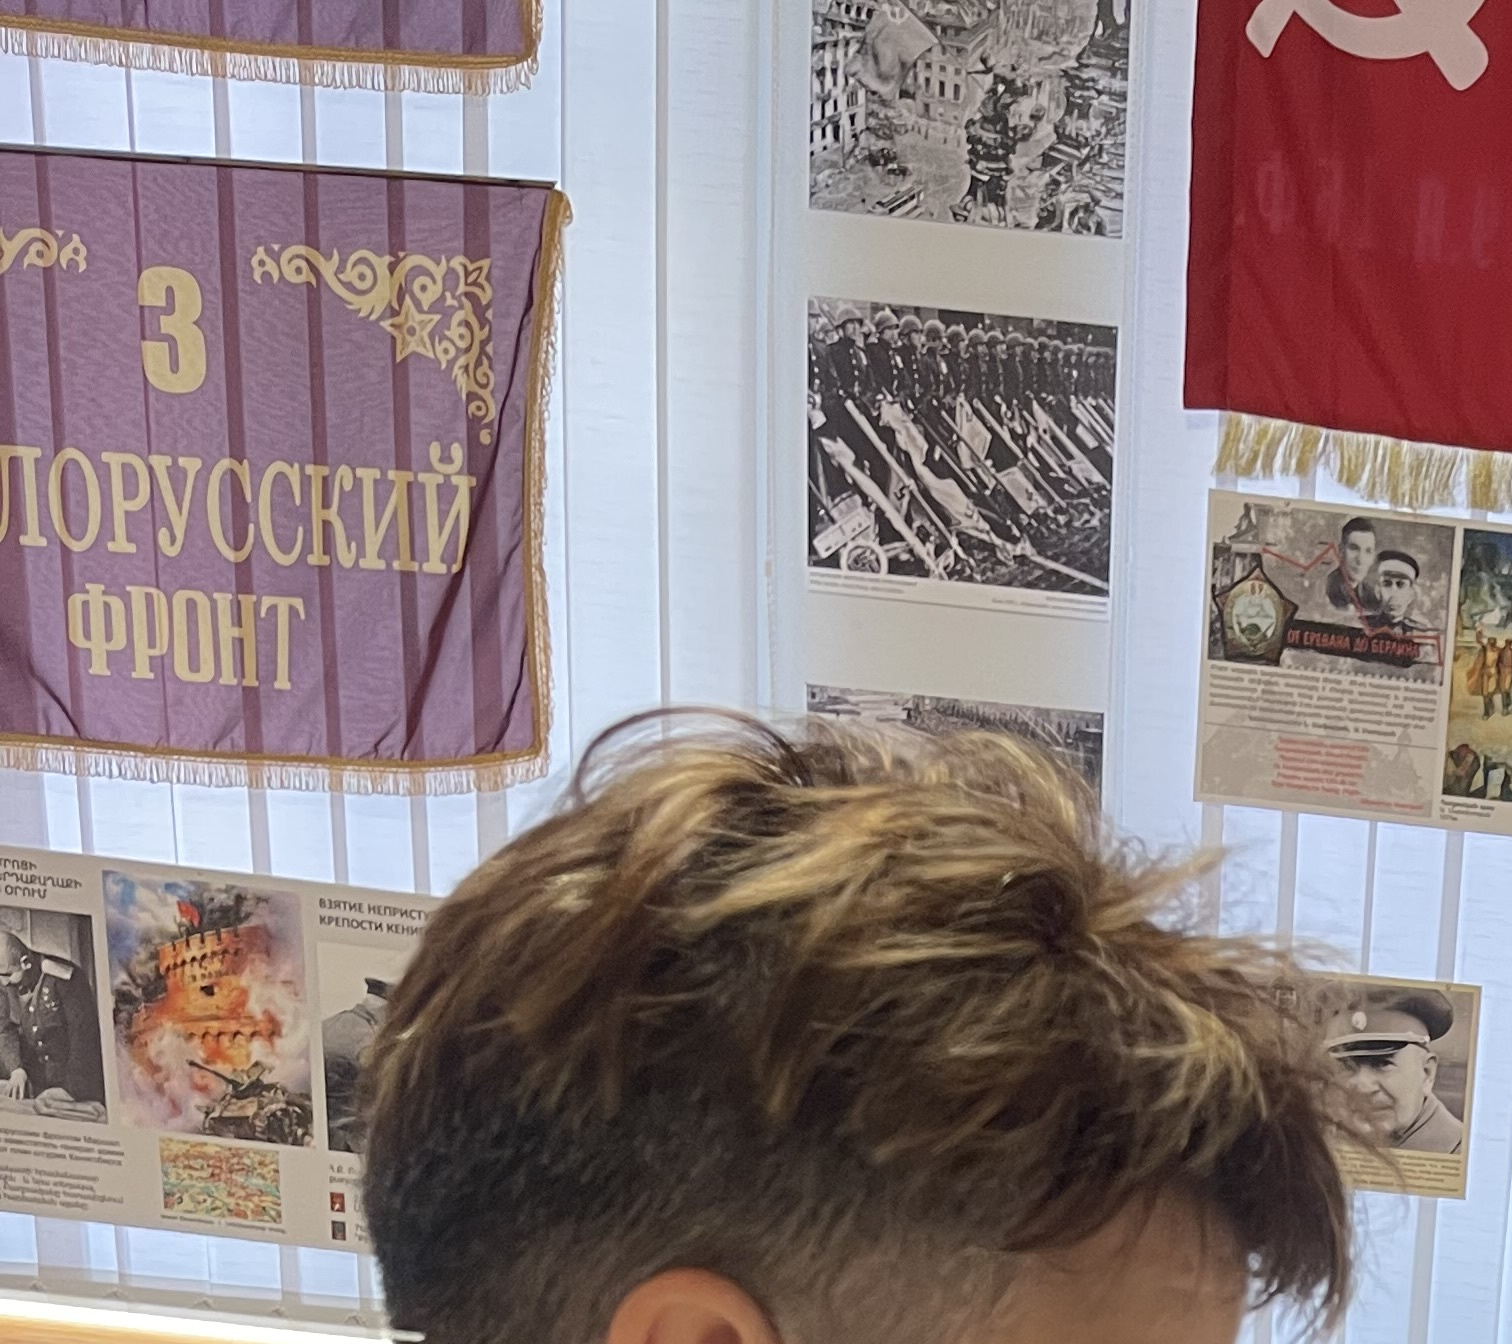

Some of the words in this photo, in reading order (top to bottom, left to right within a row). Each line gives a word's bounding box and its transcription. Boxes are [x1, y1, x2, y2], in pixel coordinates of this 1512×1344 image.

[136, 265, 207, 395] 3
[67, 583, 306, 692] ФРОНТ
[318, 898, 365, 914] ВЗЯТИЕ
[318, 915, 384, 934] КРЕПОСТИ
